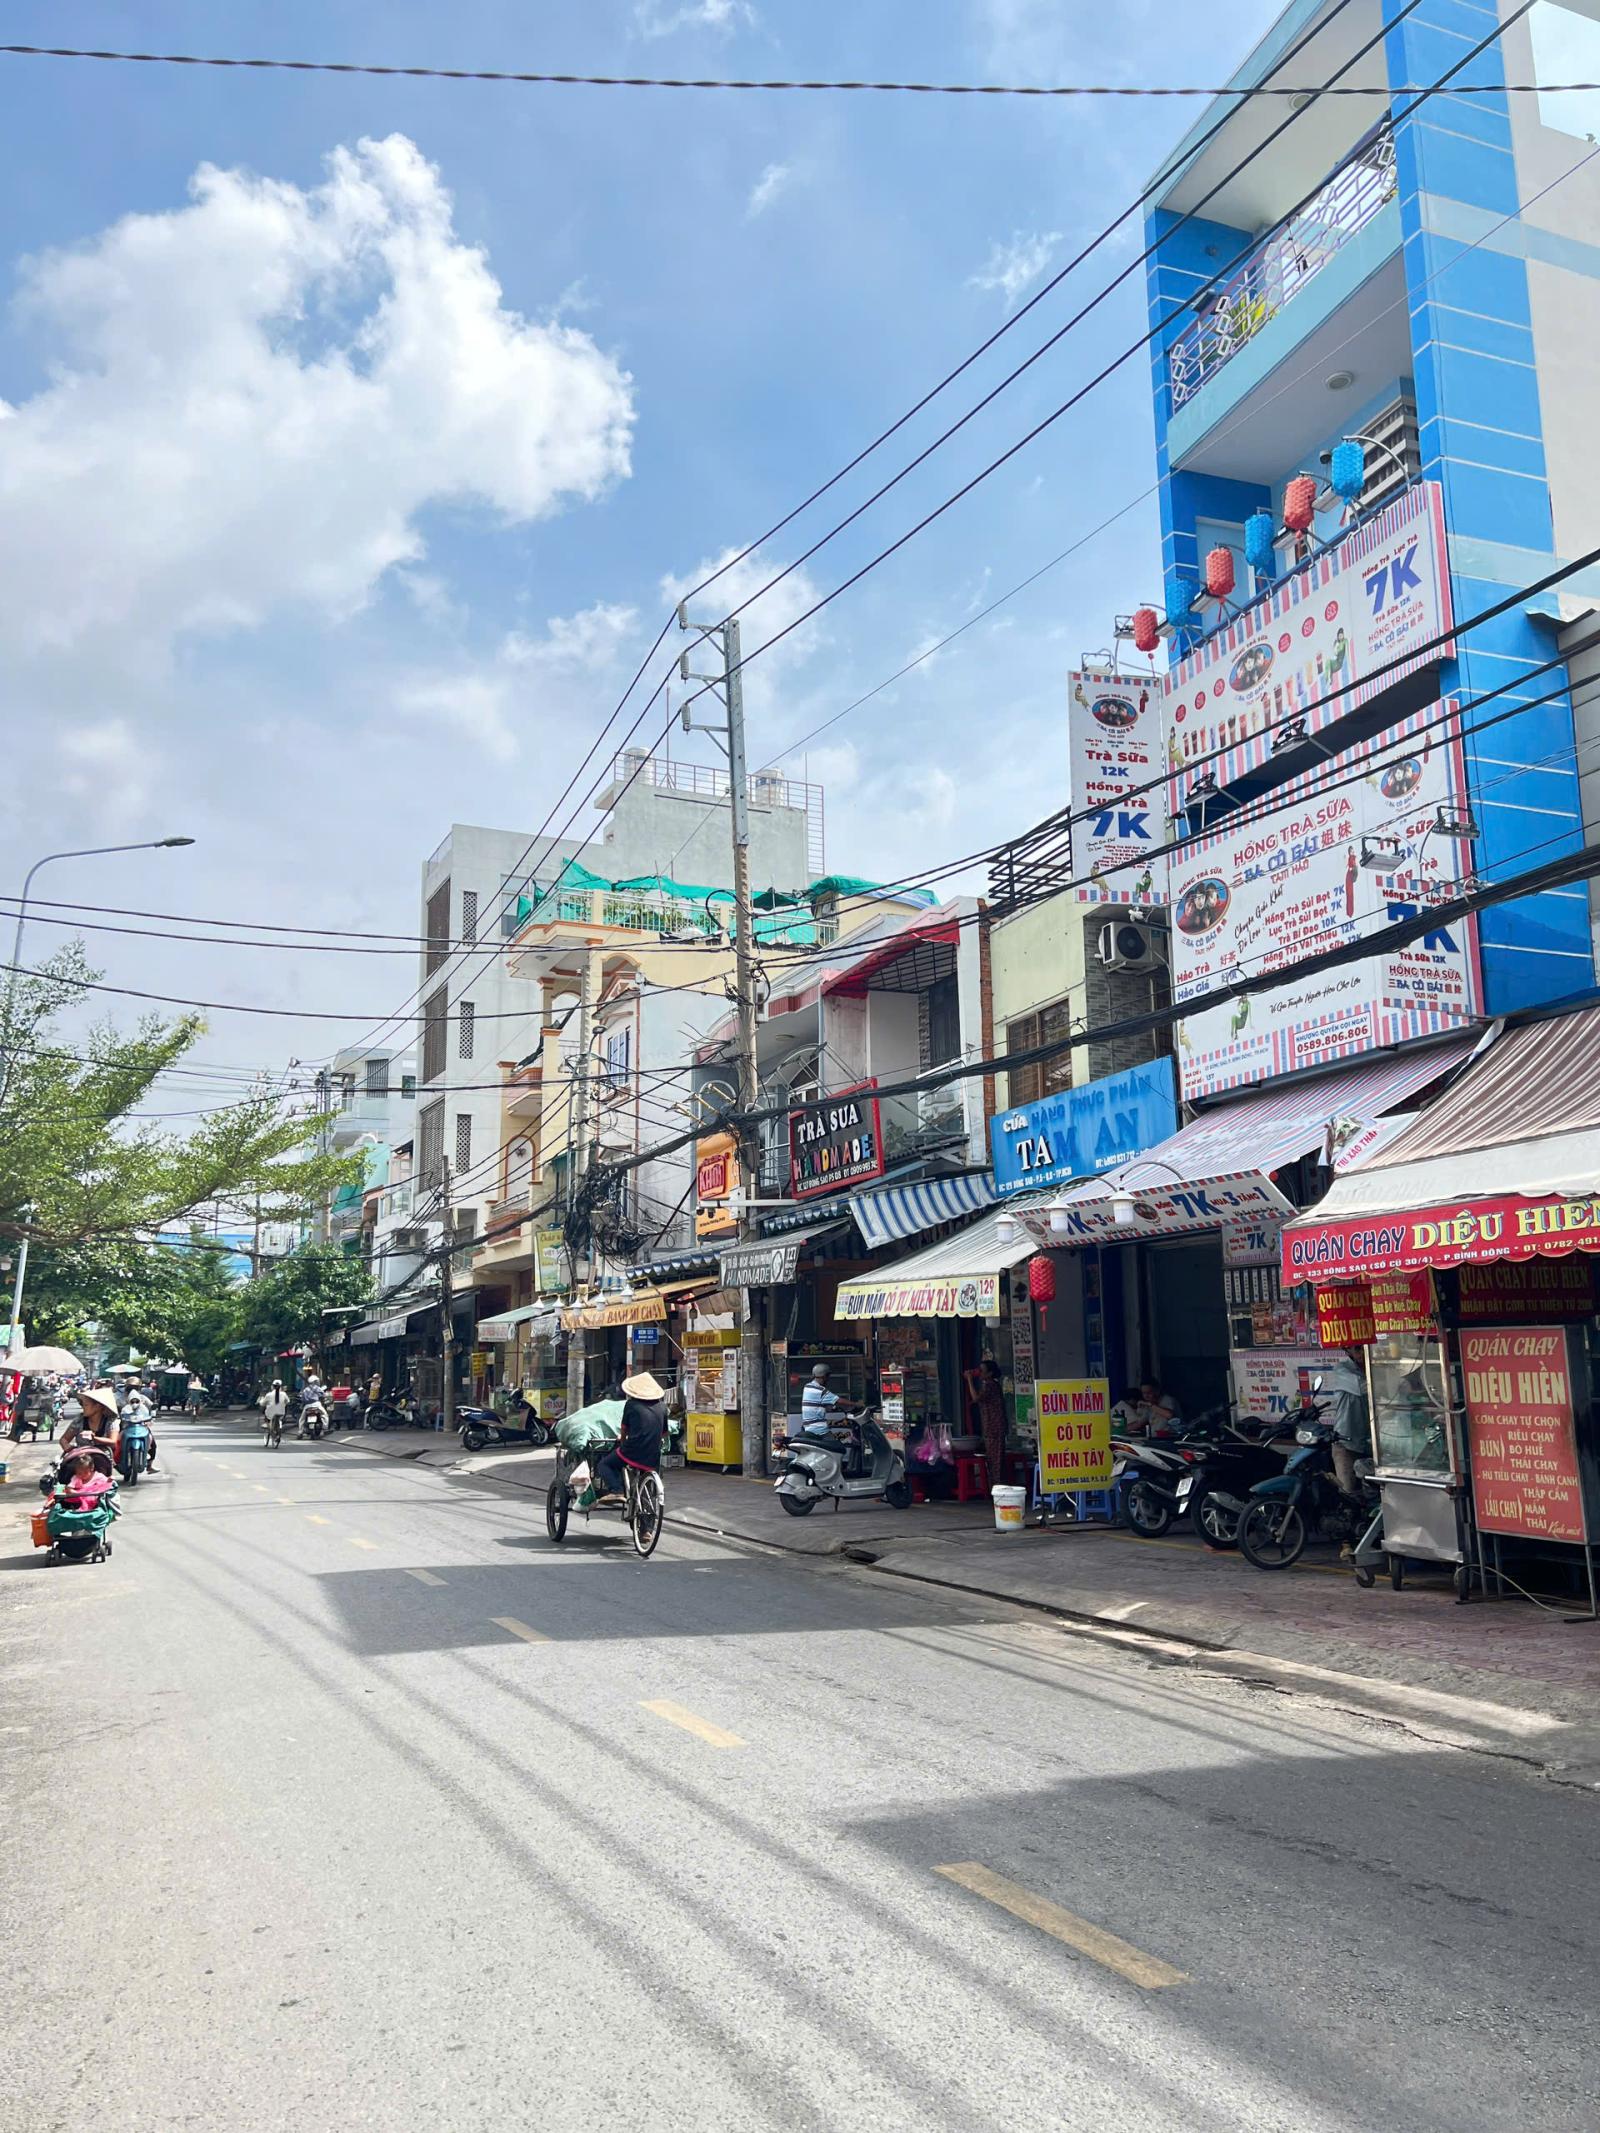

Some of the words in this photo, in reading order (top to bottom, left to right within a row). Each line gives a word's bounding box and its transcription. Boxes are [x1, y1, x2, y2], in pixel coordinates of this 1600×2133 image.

[1366, 543, 1422, 615] 7K
[1085, 750, 1112, 761] Trà
[1117, 752, 1148, 763] Sữa
[1101, 766, 1129, 777] 12K
[1086, 781, 1123, 794] Hồng
[1086, 810, 1152, 839] 7K
[1233, 834, 1278, 868] HỒNG
[1279, 813, 1315, 844] TRÀ
[1316, 798, 1352, 825] SỮA
[1196, 870, 1209, 880] TRÀ
[1264, 911, 1285, 926] Hồng
[1287, 904, 1299, 918] Trà
[1316, 891, 1330, 903] Bọt
[1333, 885, 1345, 897] 7K
[1382, 889, 1405, 901] Hồng
[1284, 919, 1297, 931] Trà
[1331, 900, 1342, 912] 7K
[1278, 933, 1290, 946] Trà
[1321, 915, 1337, 929] 10K
[1263, 951, 1283, 966] Hồng
[1285, 943, 1297, 957] Trà
[1340, 921, 1356, 935] 12K
[1400, 952, 1412, 961] Trà
[1415, 954, 1430, 962] Sữa
[1432, 955, 1446, 964] 12K
[1194, 962, 1210, 977] Trà
[1389, 963, 1418, 977] HỒNG
[1421, 966, 1441, 978] TRÀ
[1442, 968, 1462, 981] SỮA
[1351, 1016, 1368, 1026] NGAY
[1297, 1025, 1369, 1053] 0589.806.806
[797, 1111, 826, 1144] TRÀ
[1002, 1111, 1029, 1133] CỬA
[1095, 1107, 1139, 1154] AN
[792, 1132, 872, 1180] HANDMADE
[1169, 1190, 1223, 1219] 7K
[1210, 1197, 1230, 1207] MUA
[1222, 1191, 1241, 1207] 3
[1252, 1186, 1271, 1201] 1
[1247, 1232, 1267, 1249] 7K
[1292, 1230, 1345, 1266] QUÁN
[1349, 1225, 1406, 1258] CHAY
[1411, 1208, 1504, 1250] DIỆU
[1307, 1270, 1321, 1278] 133
[1323, 1266, 1347, 1275] BÔNG
[1349, 1263, 1367, 1273] SAO
[1405, 1256, 1433, 1266] 30/4)
[1444, 1250, 1478, 1261] P.BÌNH
[726, 1267, 770, 1286] HANDMADE
[980, 1279, 994, 1295] 129
[848, 1290, 865, 1315] BÚN
[865, 1288, 886, 1313] MẮM
[936, 1281, 958, 1312] TÂY
[1318, 1289, 1344, 1313] QUÁN
[1347, 1291, 1371, 1308] CHAY
[641, 1303, 662, 1320] CHAY
[1321, 1315, 1348, 1347] DIỆU
[1467, 1333, 1511, 1361] QUÁN
[1513, 1336, 1559, 1356] CHAY
[1468, 1366, 1512, 1410] DIỆU
[1518, 1360, 1566, 1405] HIỀN
[1041, 1389, 1069, 1414] BÚN
[1072, 1385, 1105, 1412] MẮM
[1268, 1395, 1290, 1413] 7K
[1057, 1422, 1073, 1441] CÔ
[1077, 1423, 1092, 1440] TƯ
[1475, 1414, 1495, 1424] CƠM
[1496, 1415, 1518, 1425] CHAY
[1520, 1415, 1532, 1428] TỰ
[1534, 1416, 1561, 1429] CHỌN
[1479, 1434, 1501, 1457] BÚN
[1531, 1432, 1555, 1442] CHAY
[1083, 1448, 1104, 1466] TÂY
[1510, 1455, 1531, 1469] THÁI
[1534, 1459, 1558, 1471] CHAY
[1511, 1472, 1528, 1482] CHAY
[1557, 1475, 1578, 1487] CANH
[1500, 1499, 1518, 1519] CHAY
